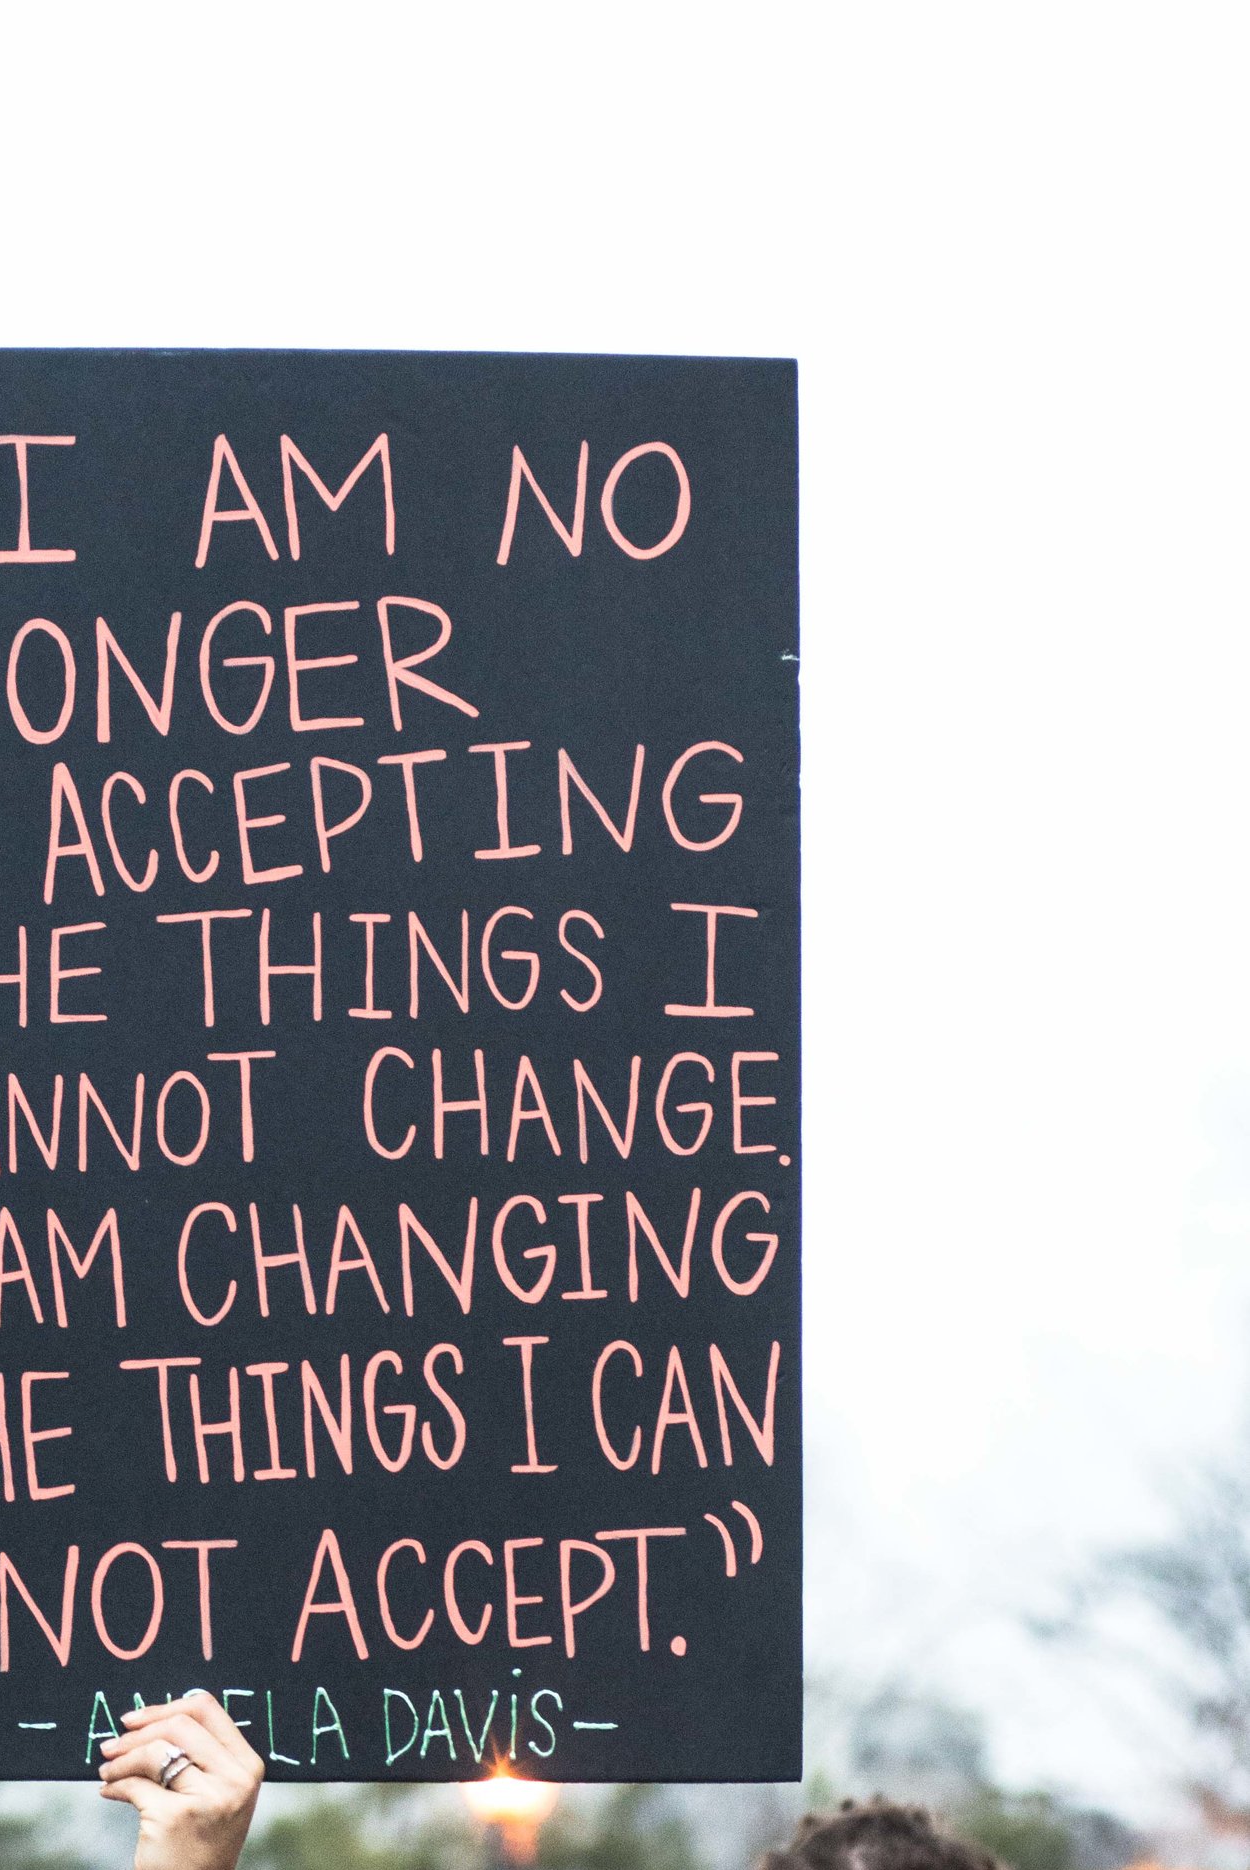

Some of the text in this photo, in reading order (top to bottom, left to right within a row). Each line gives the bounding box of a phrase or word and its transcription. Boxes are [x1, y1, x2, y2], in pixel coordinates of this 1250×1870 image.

[194, 432, 396, 569] AM
[496, 441, 692, 566] NO
[43, 740, 744, 905] ACCEPTING
[157, 904, 605, 1028] THINGS
[664, 902, 759, 1019] I
[362, 1046, 792, 1167] CHANGE.
[177, 1187, 781, 1329] CHANGING
[119, 1342, 467, 1485] THINGS
[502, 1335, 559, 1474] I
[591, 1339, 781, 1476] CAN
